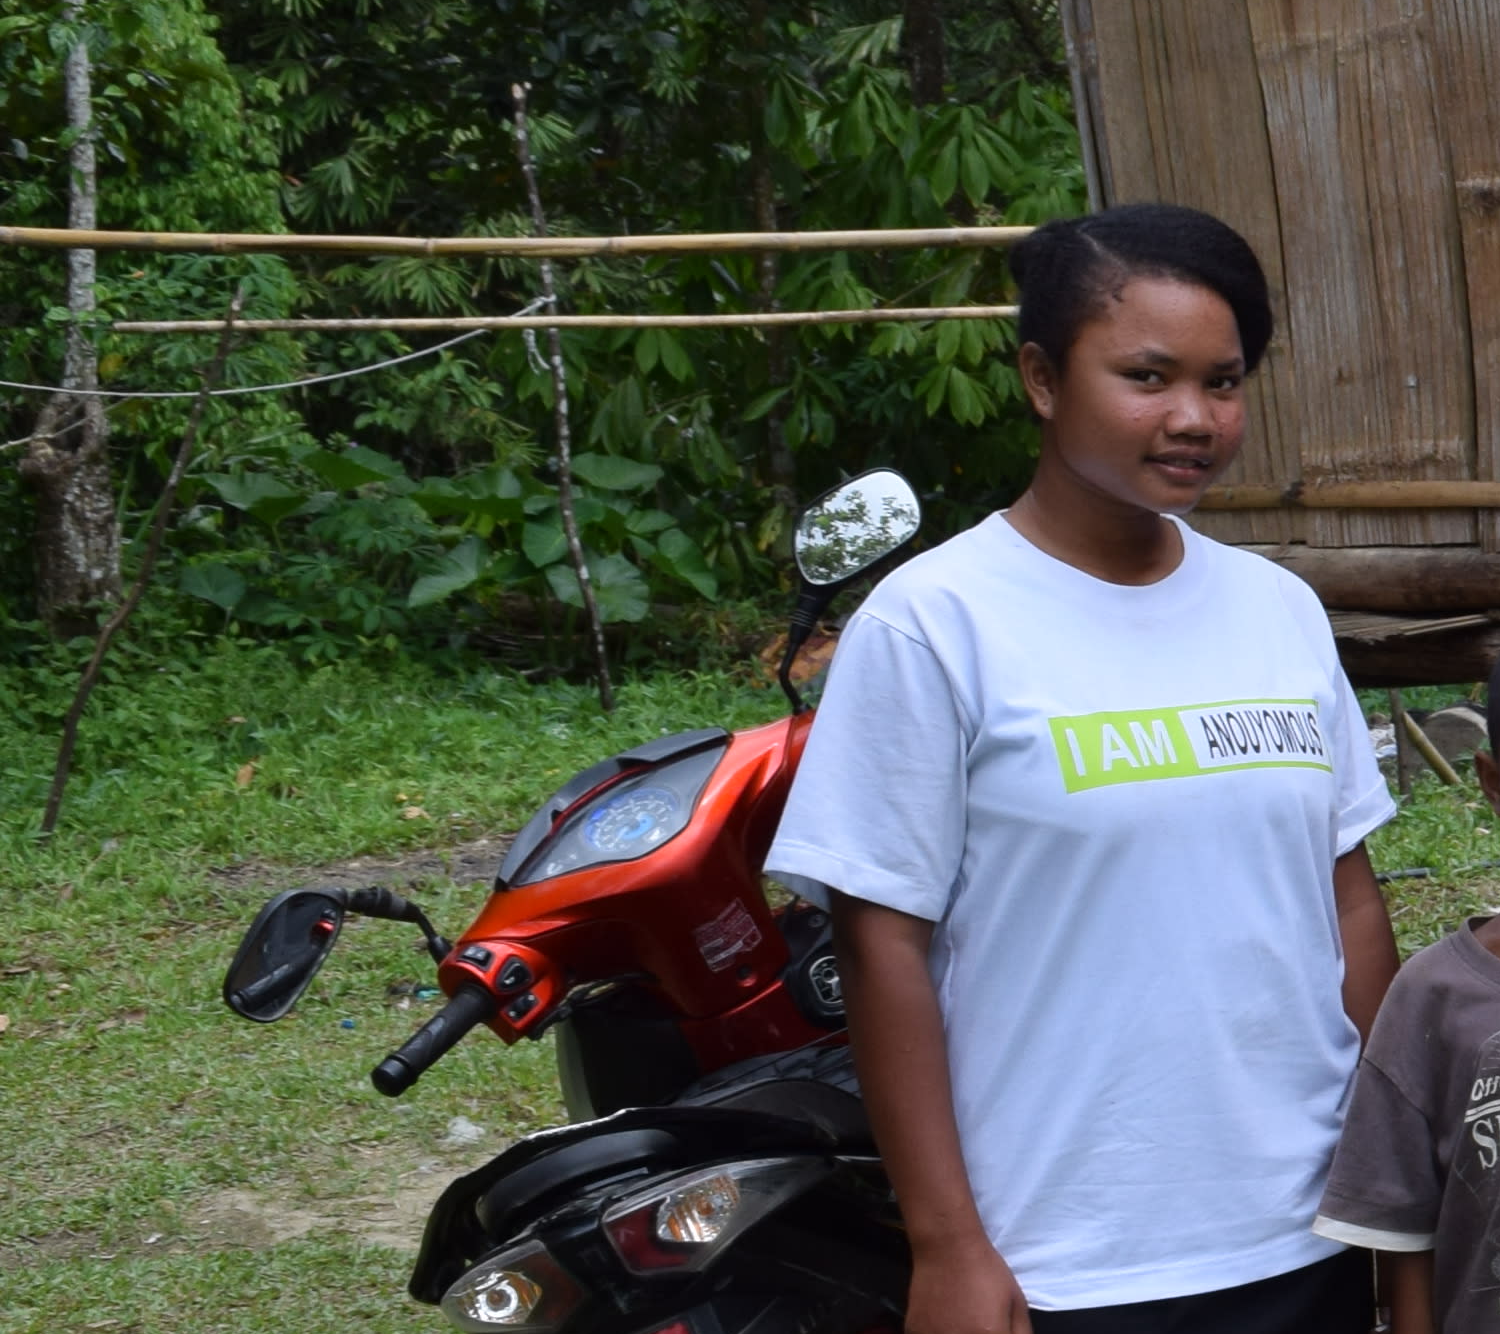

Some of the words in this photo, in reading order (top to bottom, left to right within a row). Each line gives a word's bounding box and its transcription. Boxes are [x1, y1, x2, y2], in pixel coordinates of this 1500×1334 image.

[1064, 727, 1087, 777] I
[1102, 718, 1178, 772] AM
[1200, 709, 1324, 759] ANOUYOMOUS
